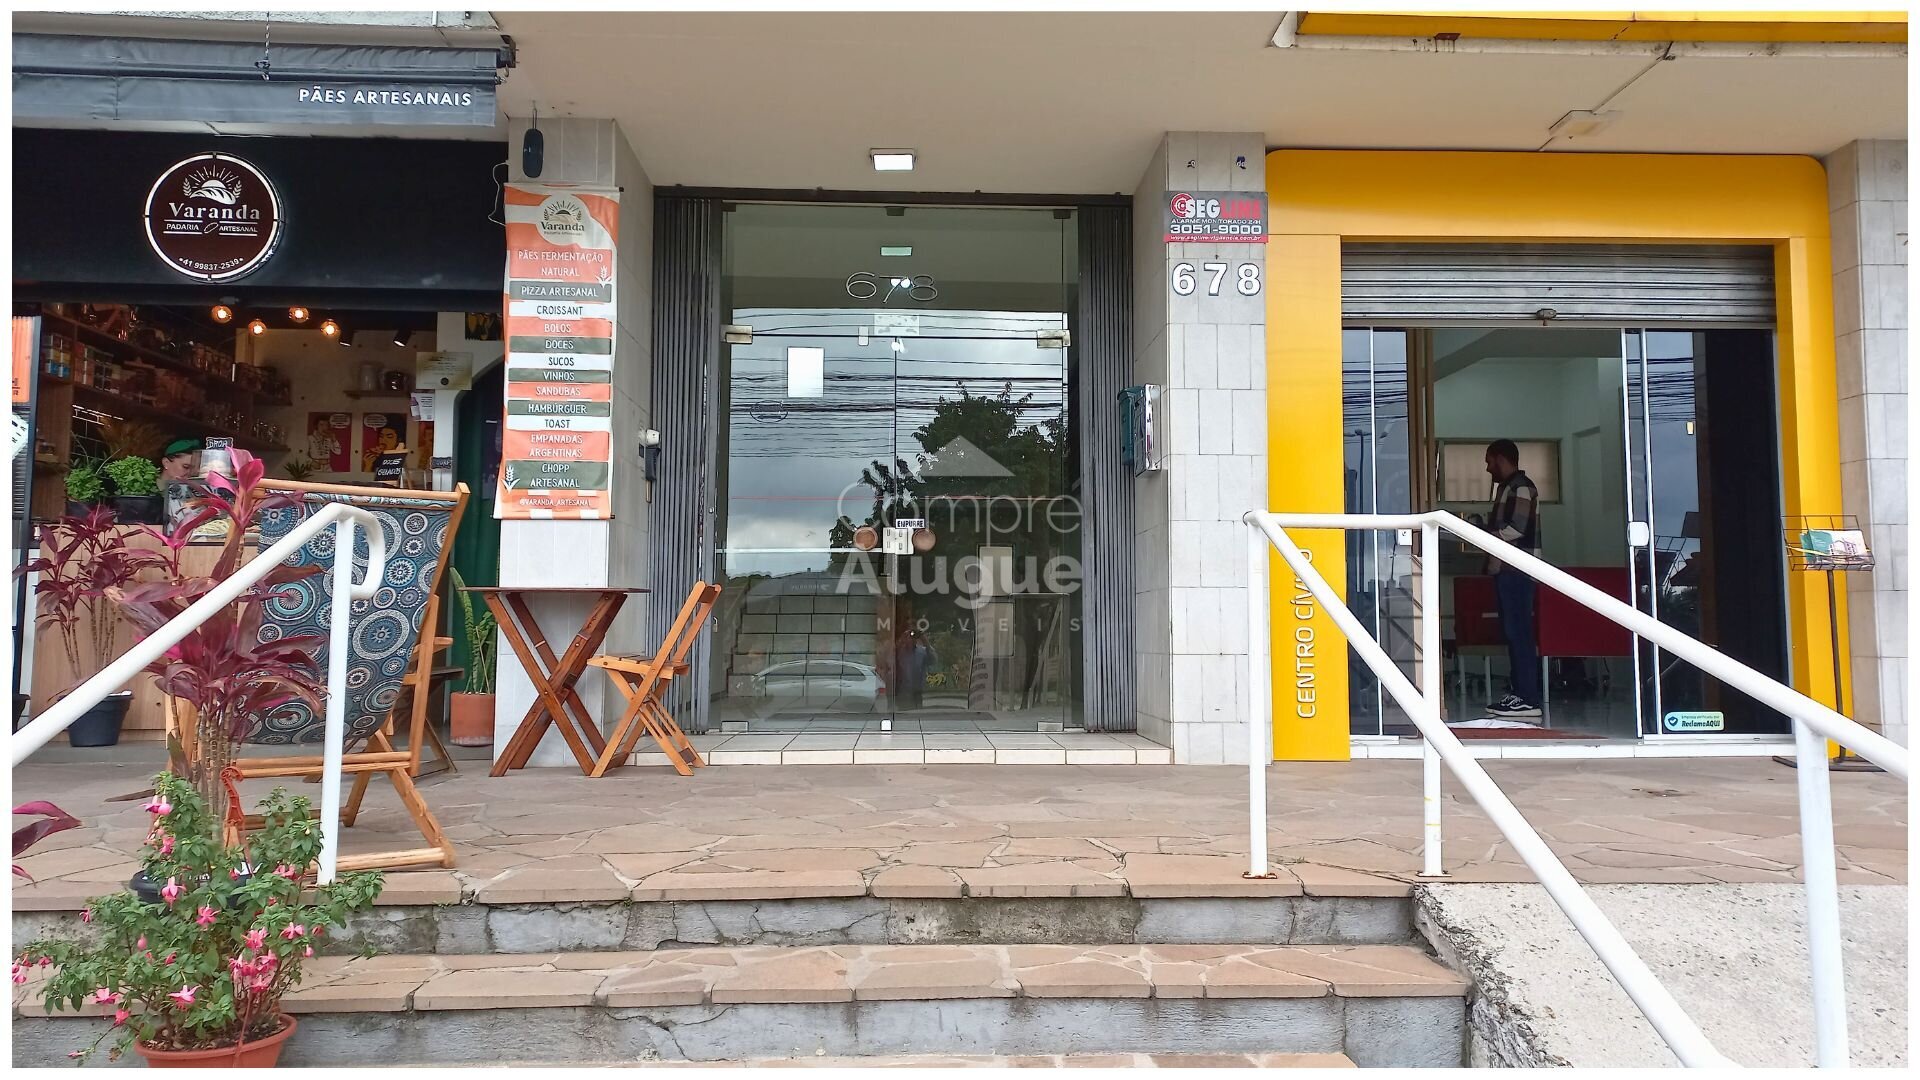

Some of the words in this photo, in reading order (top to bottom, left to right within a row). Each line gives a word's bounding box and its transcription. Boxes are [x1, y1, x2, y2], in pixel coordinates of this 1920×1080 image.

[298, 86, 346, 103] PÃES
[353, 90, 472, 106] ARTESANAIS
[168, 202, 260, 220] Varanda
[166, 223, 199, 231] PADARIA
[541, 221, 585, 232] Varanda
[1170, 224, 1262, 234] 3051-9000
[518, 250, 539, 260] PÃES
[541, 251, 604, 263] FERMENTAÇÃO
[182, 258, 193, 267] 41
[194, 258, 240, 270] 99837-2539
[541, 267, 580, 277] NATURAL
[1172, 263, 1262, 296] 678
[521, 286, 547, 296] PIZZA
[549, 287, 599, 298] ARTESANAL
[846, 272, 938, 303] 678
[536, 305, 583, 316] CROISSANT
[544, 323, 572, 333] BOLOS
[545, 340, 574, 350] DOCES
[548, 356, 574, 366] SUCOS
[543, 371, 575, 381] VINHOS
[536, 386, 581, 396] SANDUBAS
[545, 419, 571, 429] TOAST
[531, 434, 583, 444] EMPANADAS
[529, 448, 582, 458] ARGENTINAS
[542, 463, 570, 473] CHOPP
[530, 479, 580, 488] ARTESANAL
[897, 520, 924, 528] EMPURRE
[1295, 627, 1316, 718] CENTRO
